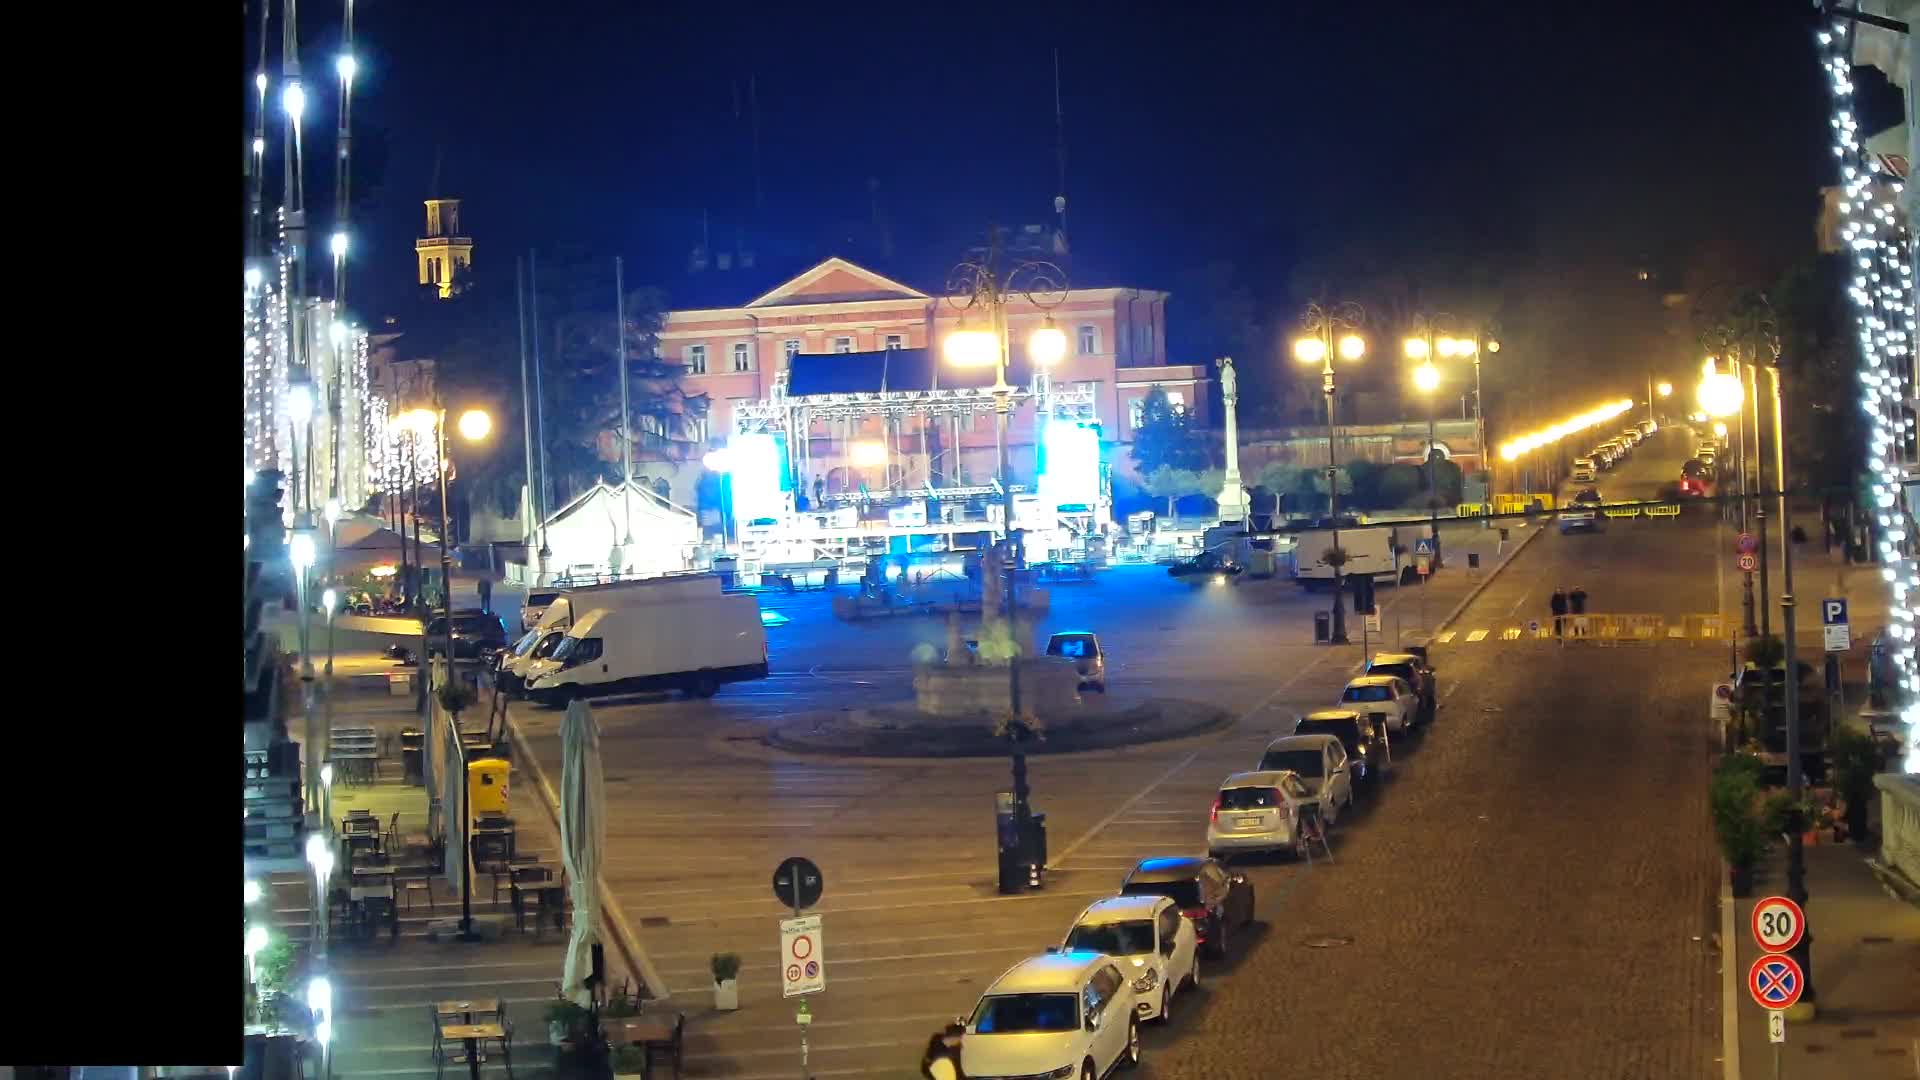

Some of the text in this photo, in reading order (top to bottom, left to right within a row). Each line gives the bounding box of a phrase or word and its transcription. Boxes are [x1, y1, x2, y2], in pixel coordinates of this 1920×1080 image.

[1743, 557, 1753, 567] 20
[1828, 602, 1842, 621] P
[1763, 912, 1791, 937] 30
